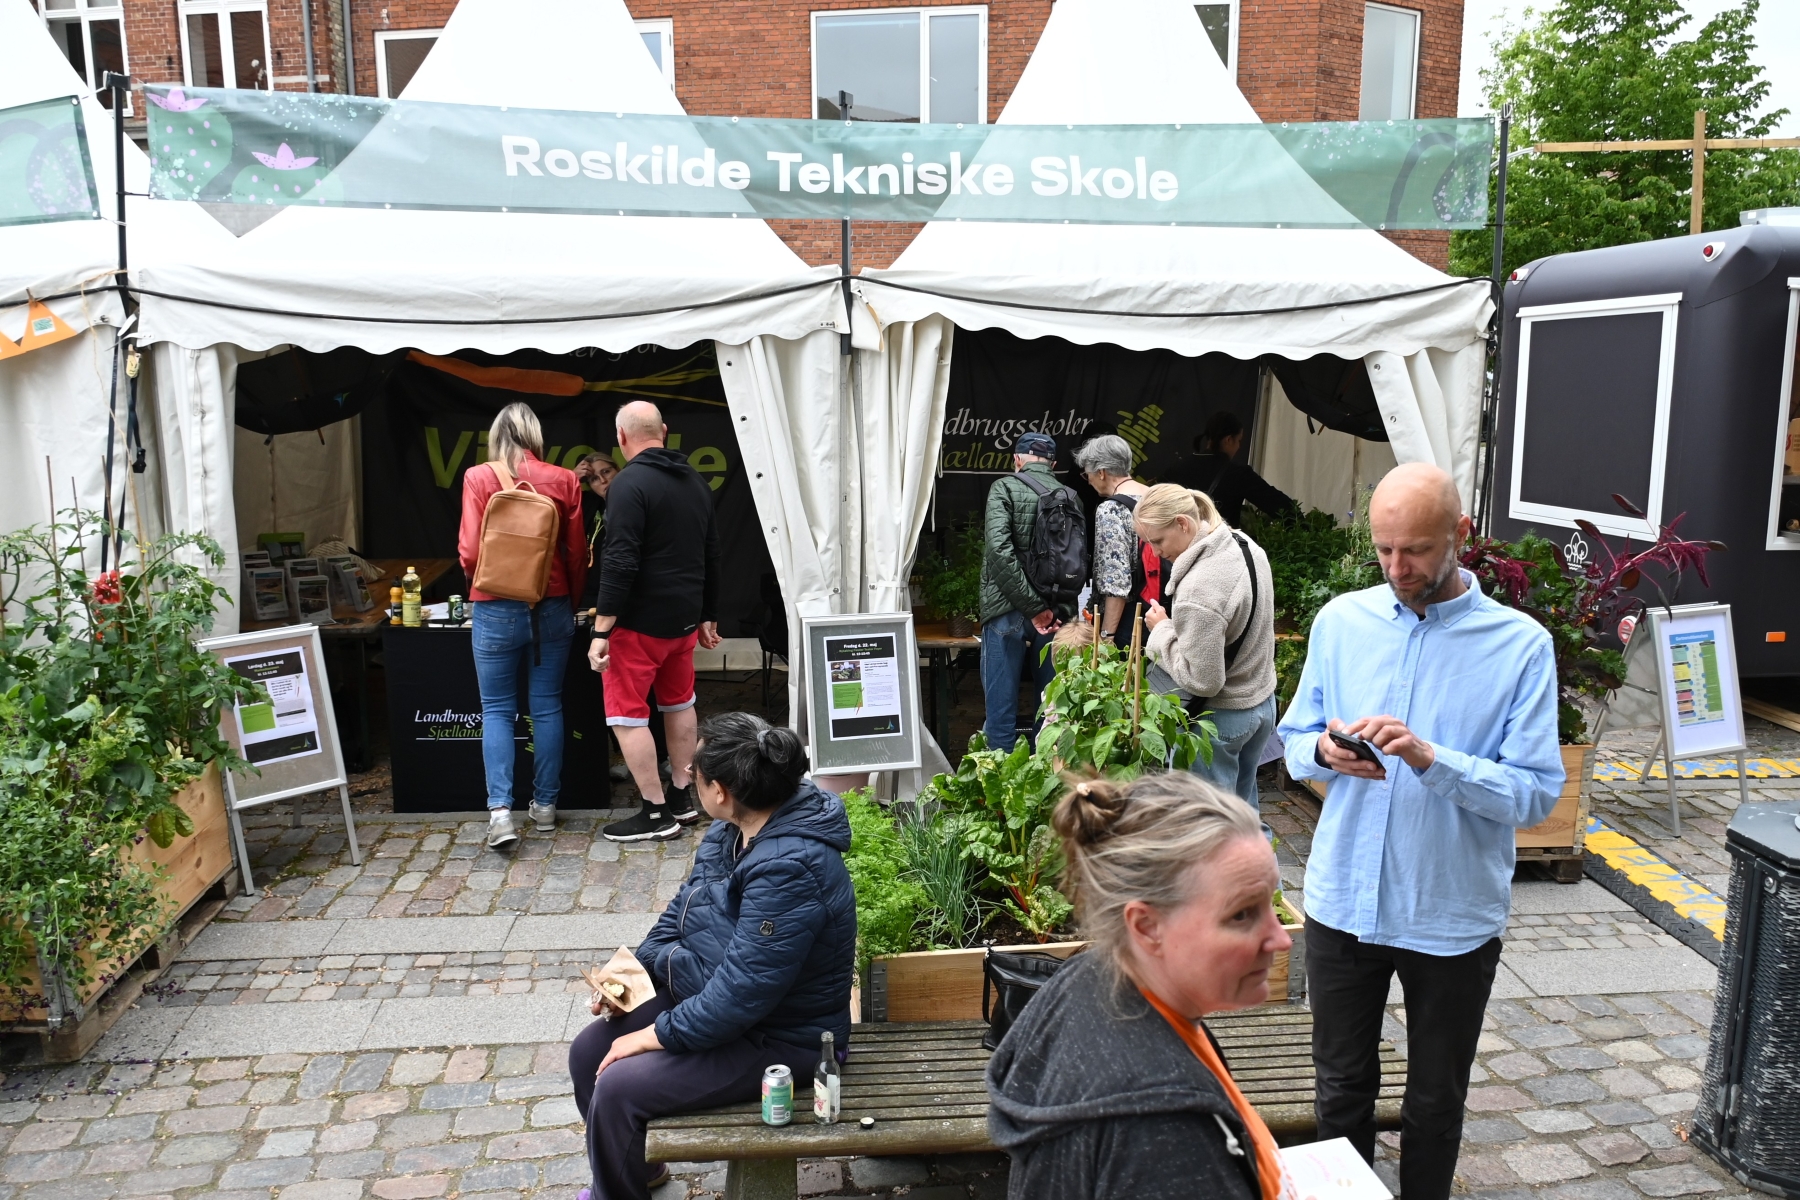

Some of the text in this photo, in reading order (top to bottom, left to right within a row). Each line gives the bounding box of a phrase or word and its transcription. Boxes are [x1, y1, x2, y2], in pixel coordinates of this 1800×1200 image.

[502, 135, 1179, 202] Roskilde Tekniske Skole
[414, 709, 519, 728] Landbrugs
